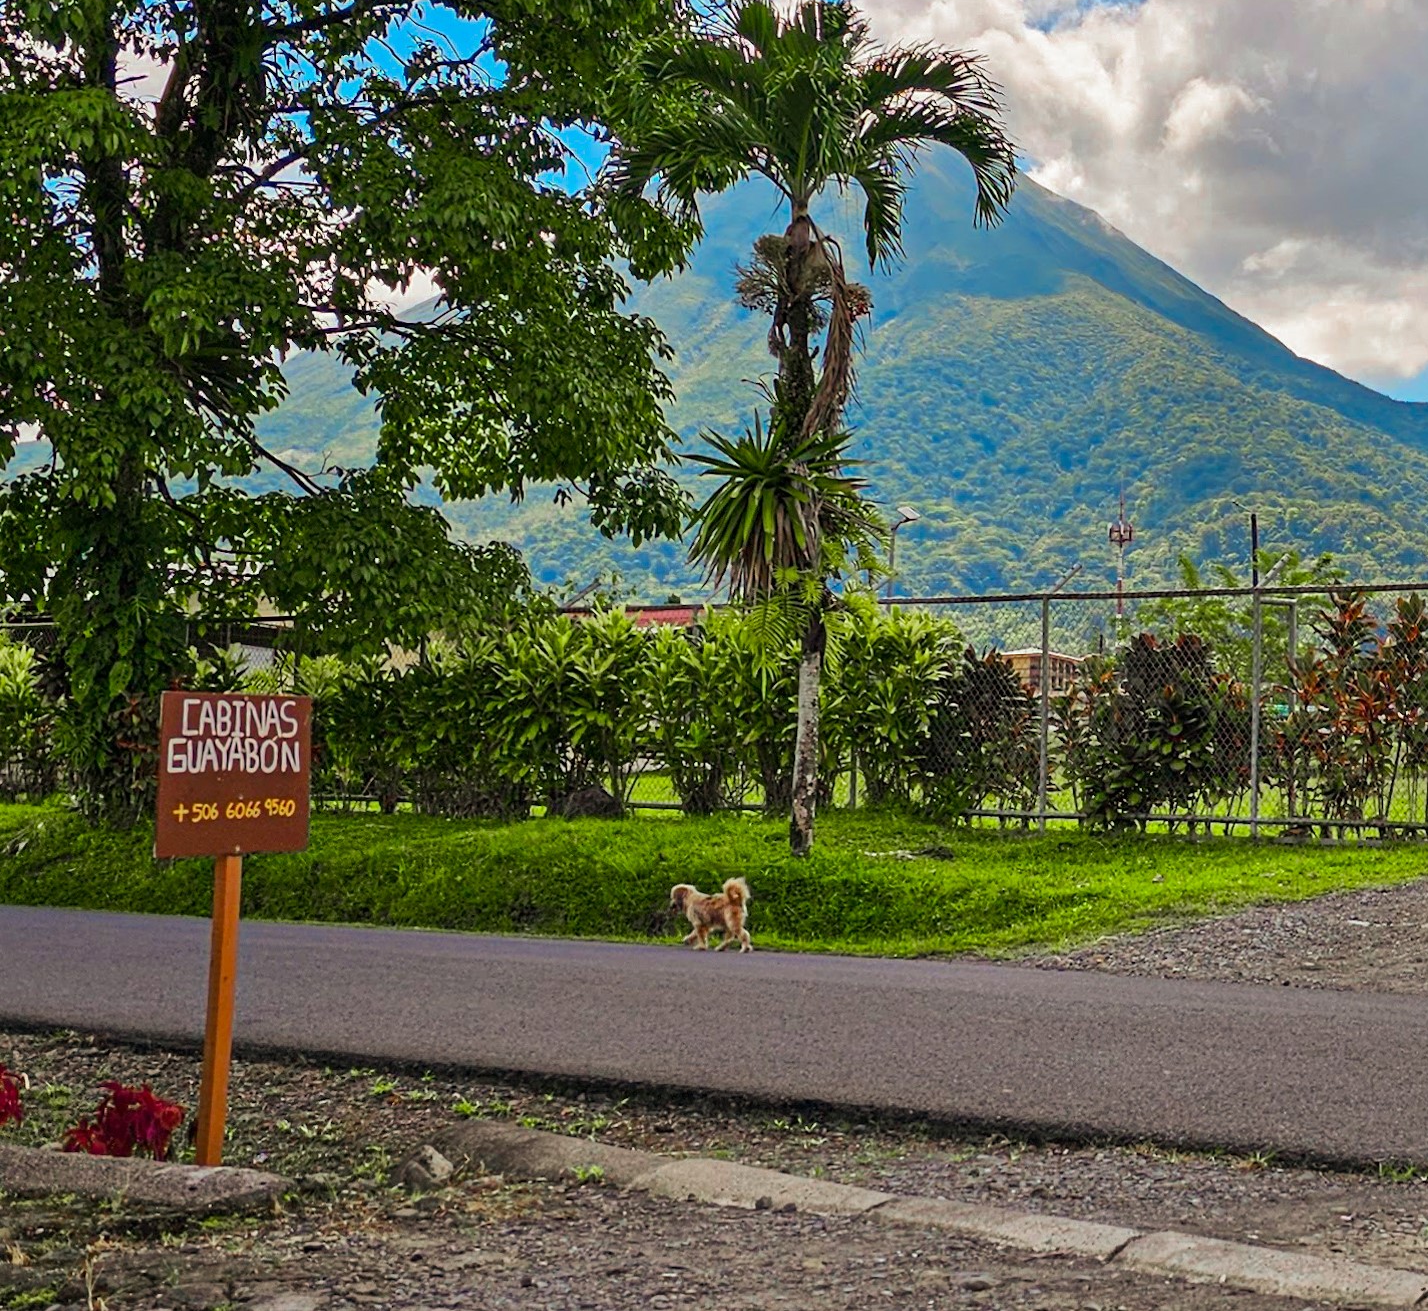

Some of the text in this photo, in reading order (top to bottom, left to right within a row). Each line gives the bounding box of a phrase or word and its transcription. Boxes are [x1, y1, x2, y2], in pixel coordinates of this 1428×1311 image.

[182, 699, 298, 738] CABINAS
[173, 798, 296, 823] +506 6066 9560
